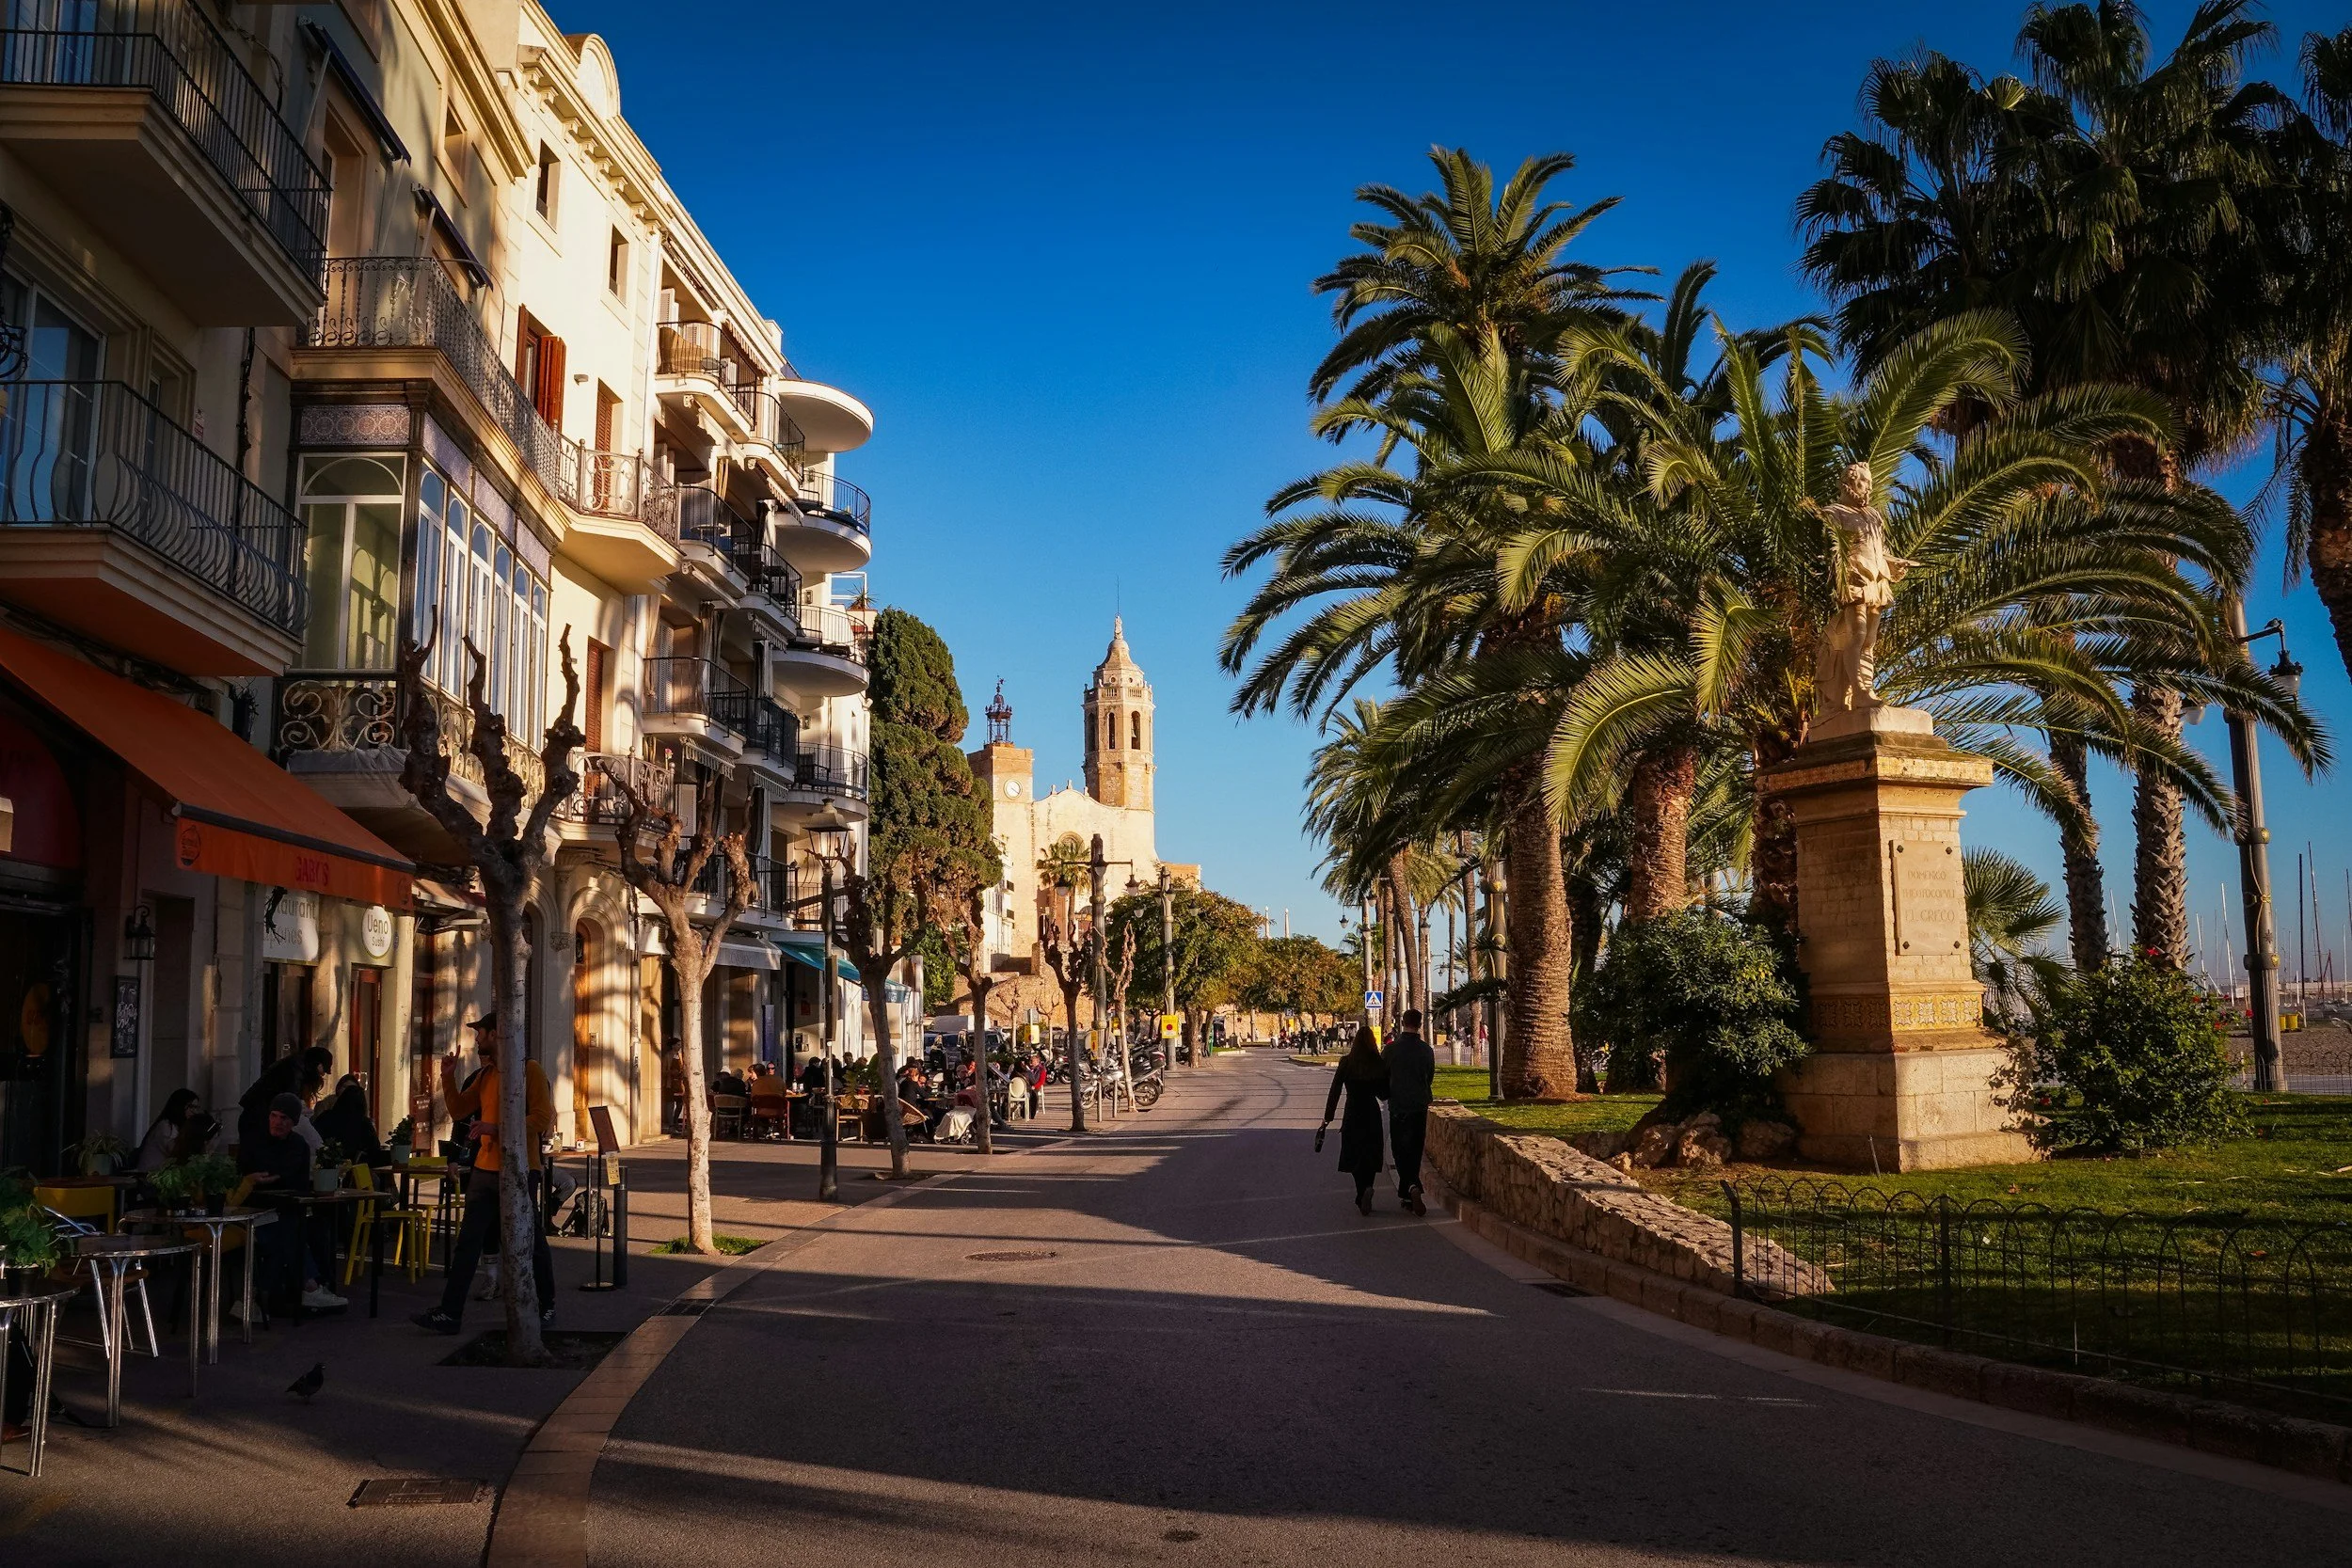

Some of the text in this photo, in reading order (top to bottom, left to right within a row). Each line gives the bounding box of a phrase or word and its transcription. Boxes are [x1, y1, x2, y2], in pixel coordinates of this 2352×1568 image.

[368, 914, 389, 934] Ueno
[1905, 909, 1955, 923] EL GRECO
